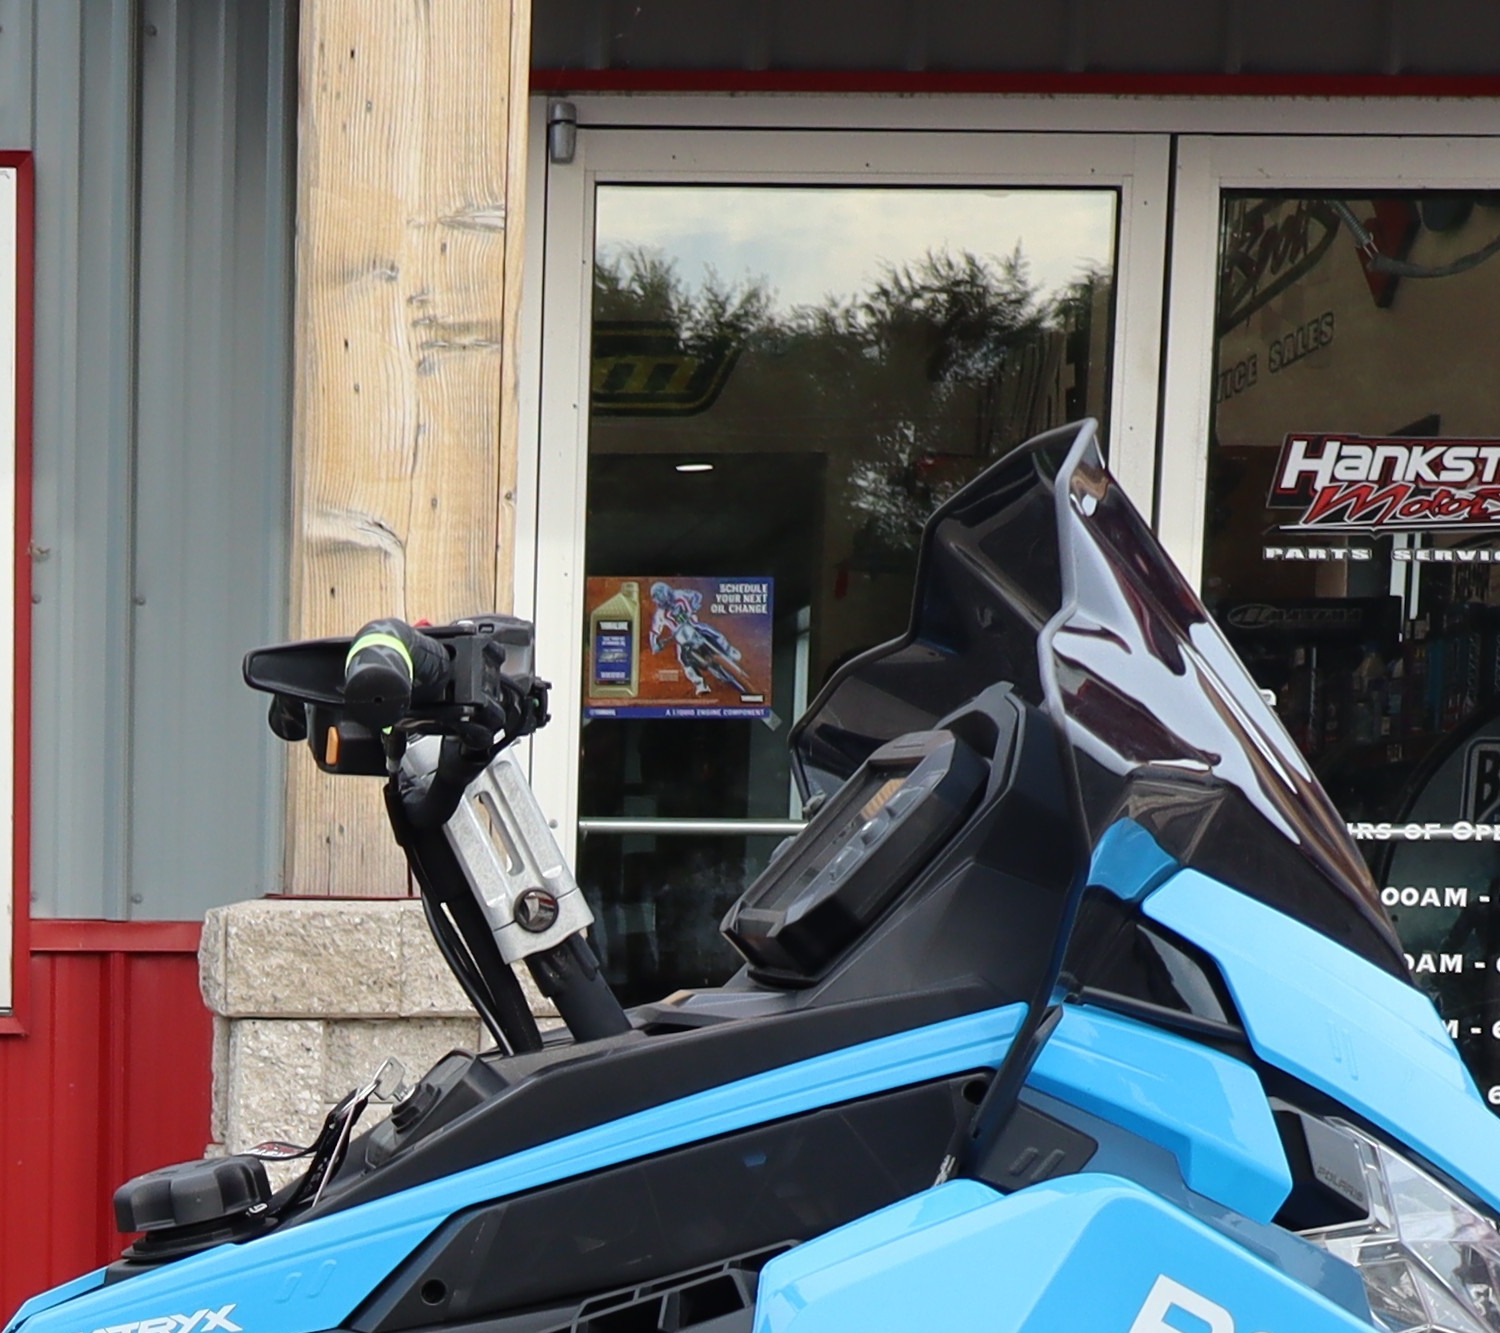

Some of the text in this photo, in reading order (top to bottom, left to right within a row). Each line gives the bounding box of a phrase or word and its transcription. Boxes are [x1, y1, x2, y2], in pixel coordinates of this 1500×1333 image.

[1263, 546, 1372, 560] PARTS
[719, 583, 768, 593] SCHEDULE
[715, 594, 768, 603] YOUR NEXT
[711, 604, 768, 614] OIL CHANGE
[1380, 887, 1468, 907] 00AM
[1316, 1165, 1364, 1200] POLARIS
